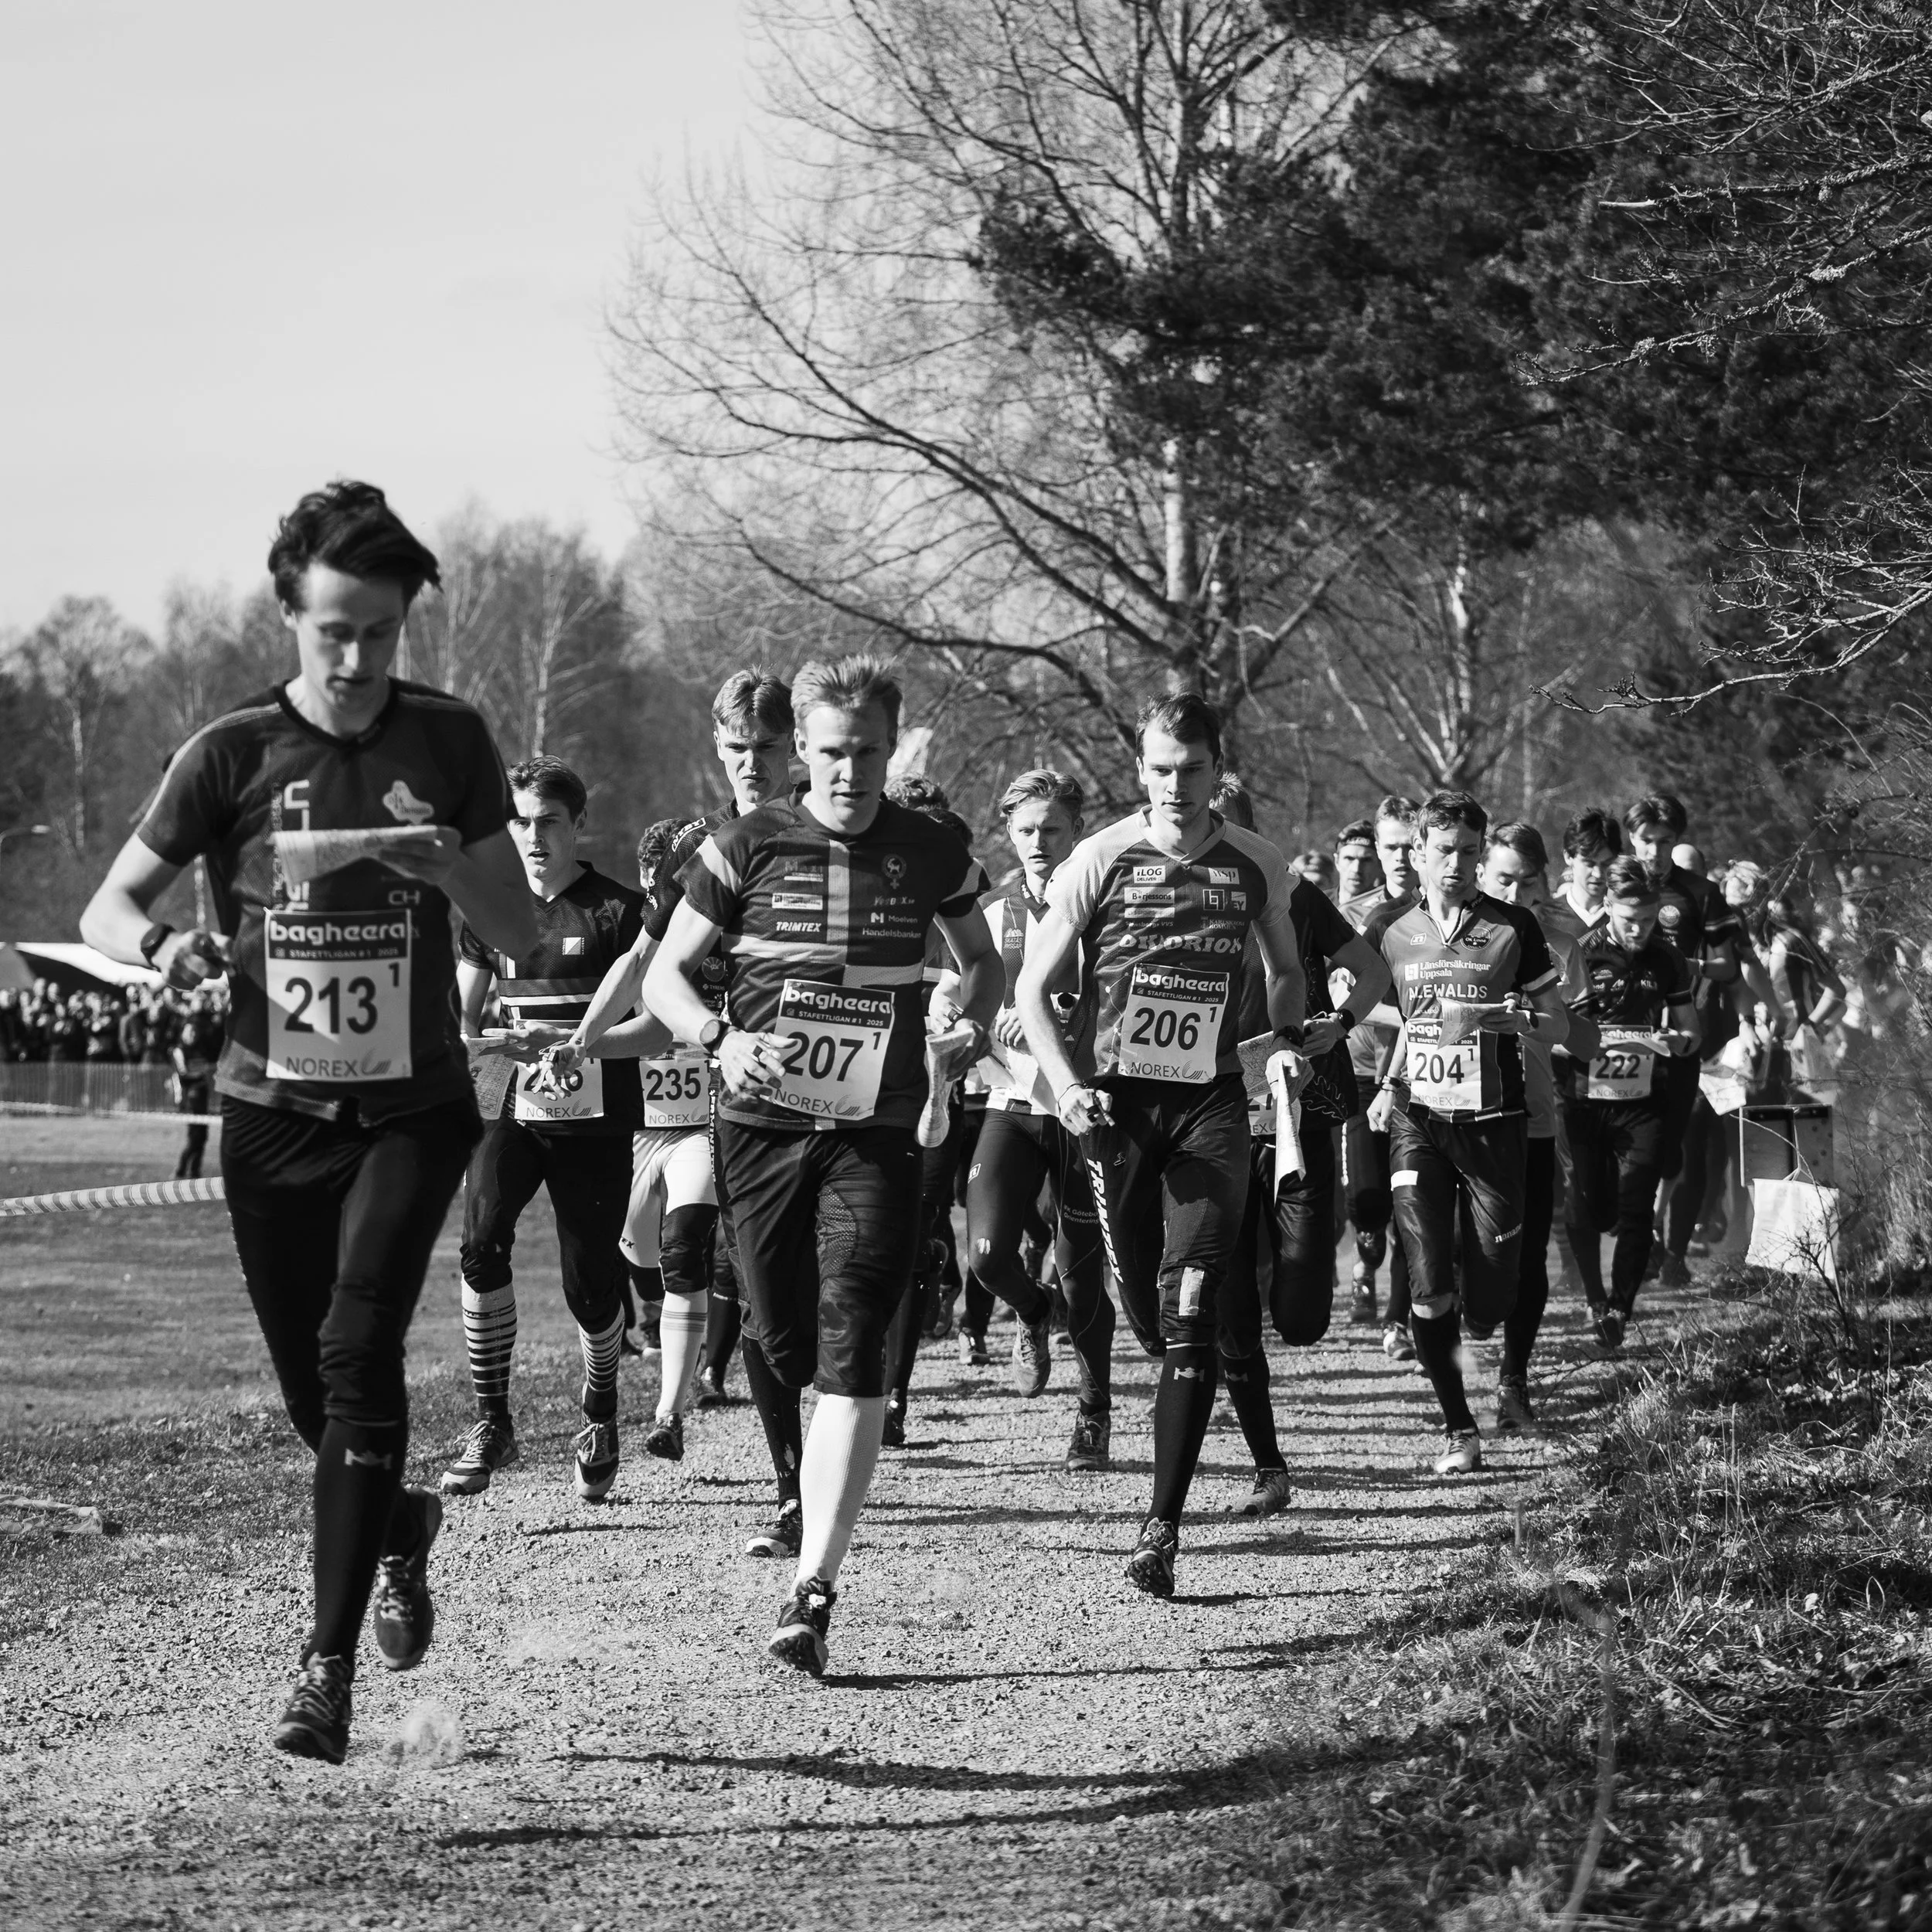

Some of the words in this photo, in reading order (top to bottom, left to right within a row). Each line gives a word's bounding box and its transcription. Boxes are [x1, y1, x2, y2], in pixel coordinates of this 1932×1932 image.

[776, 921, 821, 932] TRIMTEX
[888, 915, 918, 923] Moelven
[270, 920, 405, 945] bagheera
[289, 949, 356, 959] STAFETTLIGAN
[1420, 959, 1491, 971] Länsförsäkringar
[389, 962, 400, 987] 1
[1135, 969, 1225, 992] bagheera
[1420, 968, 1452, 980] Uppsala
[784, 986, 890, 1014] bagheera
[1148, 990, 1191, 1001] STAFETTLIGAN
[284, 976, 377, 1034] 213
[798, 1011, 850, 1023] STAFETTLIGAN
[1209, 1006, 1218, 1022] 1
[1130, 1007, 1201, 1050] 206
[872, 1032, 882, 1050] 1
[781, 1031, 864, 1082] 207
[1468, 1048, 1474, 1061] 1
[286, 1056, 359, 1077] NOREX
[1131, 1062, 1181, 1078] NOREX
[1415, 1053, 1464, 1083] 204
[1595, 1054, 1641, 1079] 222
[646, 1067, 701, 1100] 235
[774, 1088, 835, 1114] NOREX
[1419, 1094, 1452, 1106] NOREX
[1596, 1088, 1628, 1097] NOREX
[527, 1107, 571, 1117] NOREX
[649, 1114, 689, 1124] NOREX
[1087, 1158, 1124, 1284] TRIMTEX
